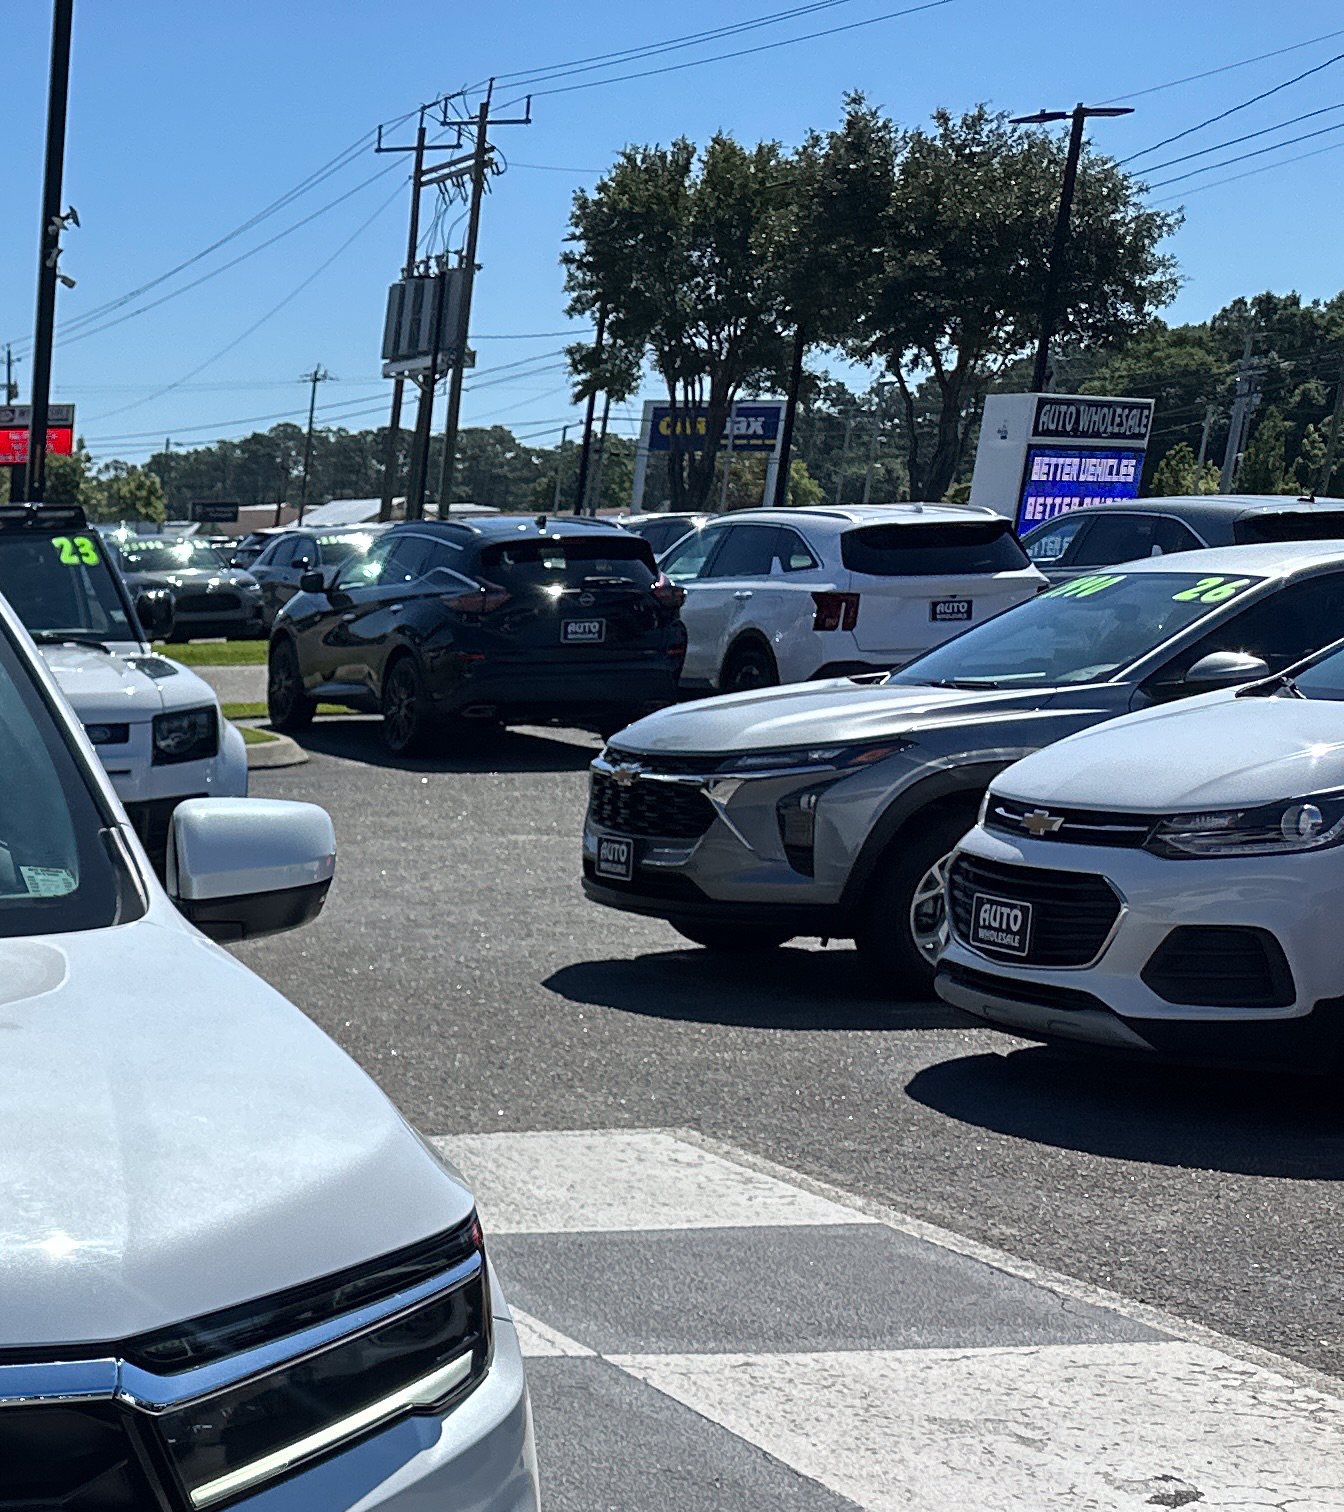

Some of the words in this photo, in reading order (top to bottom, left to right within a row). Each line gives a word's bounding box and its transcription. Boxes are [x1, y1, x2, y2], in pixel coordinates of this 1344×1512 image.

[1039, 404, 1076, 432] AUTO
[1079, 405, 1150, 435] WHOLESALE
[1031, 457, 1081, 481] BETTER
[1079, 458, 1136, 482] VEHICLES
[52, 536, 100, 567] 23
[1172, 577, 1251, 603] 26
[936, 602, 968, 613] AUTO
[568, 622, 600, 633] AUTO
[601, 841, 628, 863] AUTO
[980, 903, 1022, 932] AUTO
